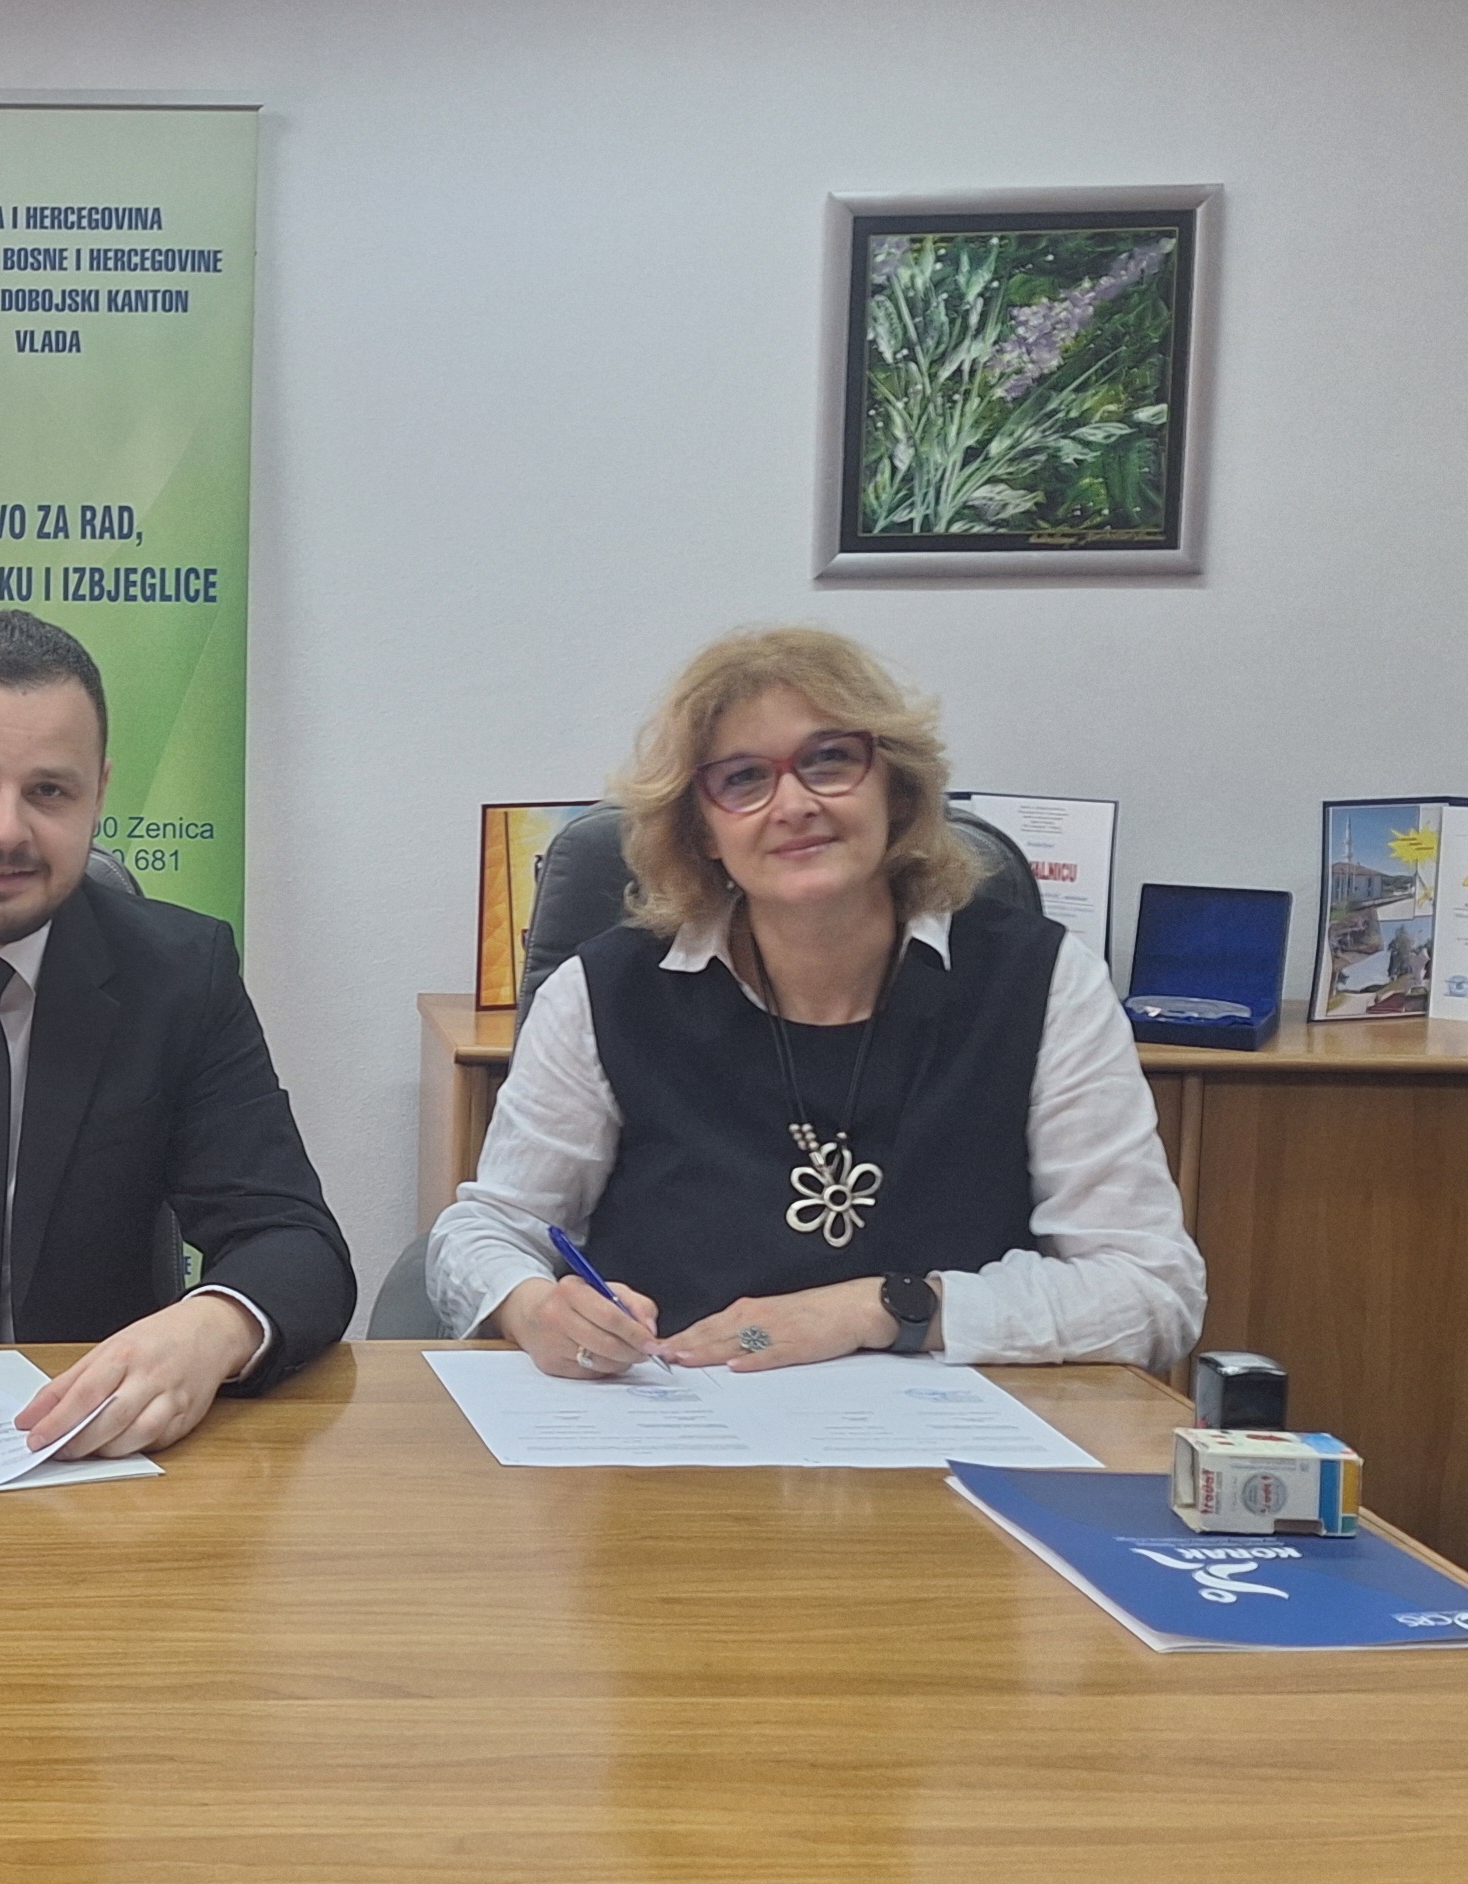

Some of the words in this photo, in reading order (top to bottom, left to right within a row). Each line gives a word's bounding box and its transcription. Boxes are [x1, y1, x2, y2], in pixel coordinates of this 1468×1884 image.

[11, 205, 19, 231] I
[25, 206, 163, 231] HERCEGOVINA
[2, 247, 68, 272] BOSNE
[75, 248, 82, 272] I
[88, 248, 223, 273] HERCEGOVINE
[107, 289, 189, 314] KANTON
[15, 329, 81, 354] VLADA
[36, 504, 70, 540] ZA
[80, 504, 143, 548] RAD,
[44, 566, 51, 602] I
[62, 566, 218, 604] IZBJEGLICE
[126, 816, 215, 840] Zenica
[134, 848, 179, 872] 681
[1029, 861, 1078, 883] ALNICU
[1174, 1546, 1303, 1560] KORAK
